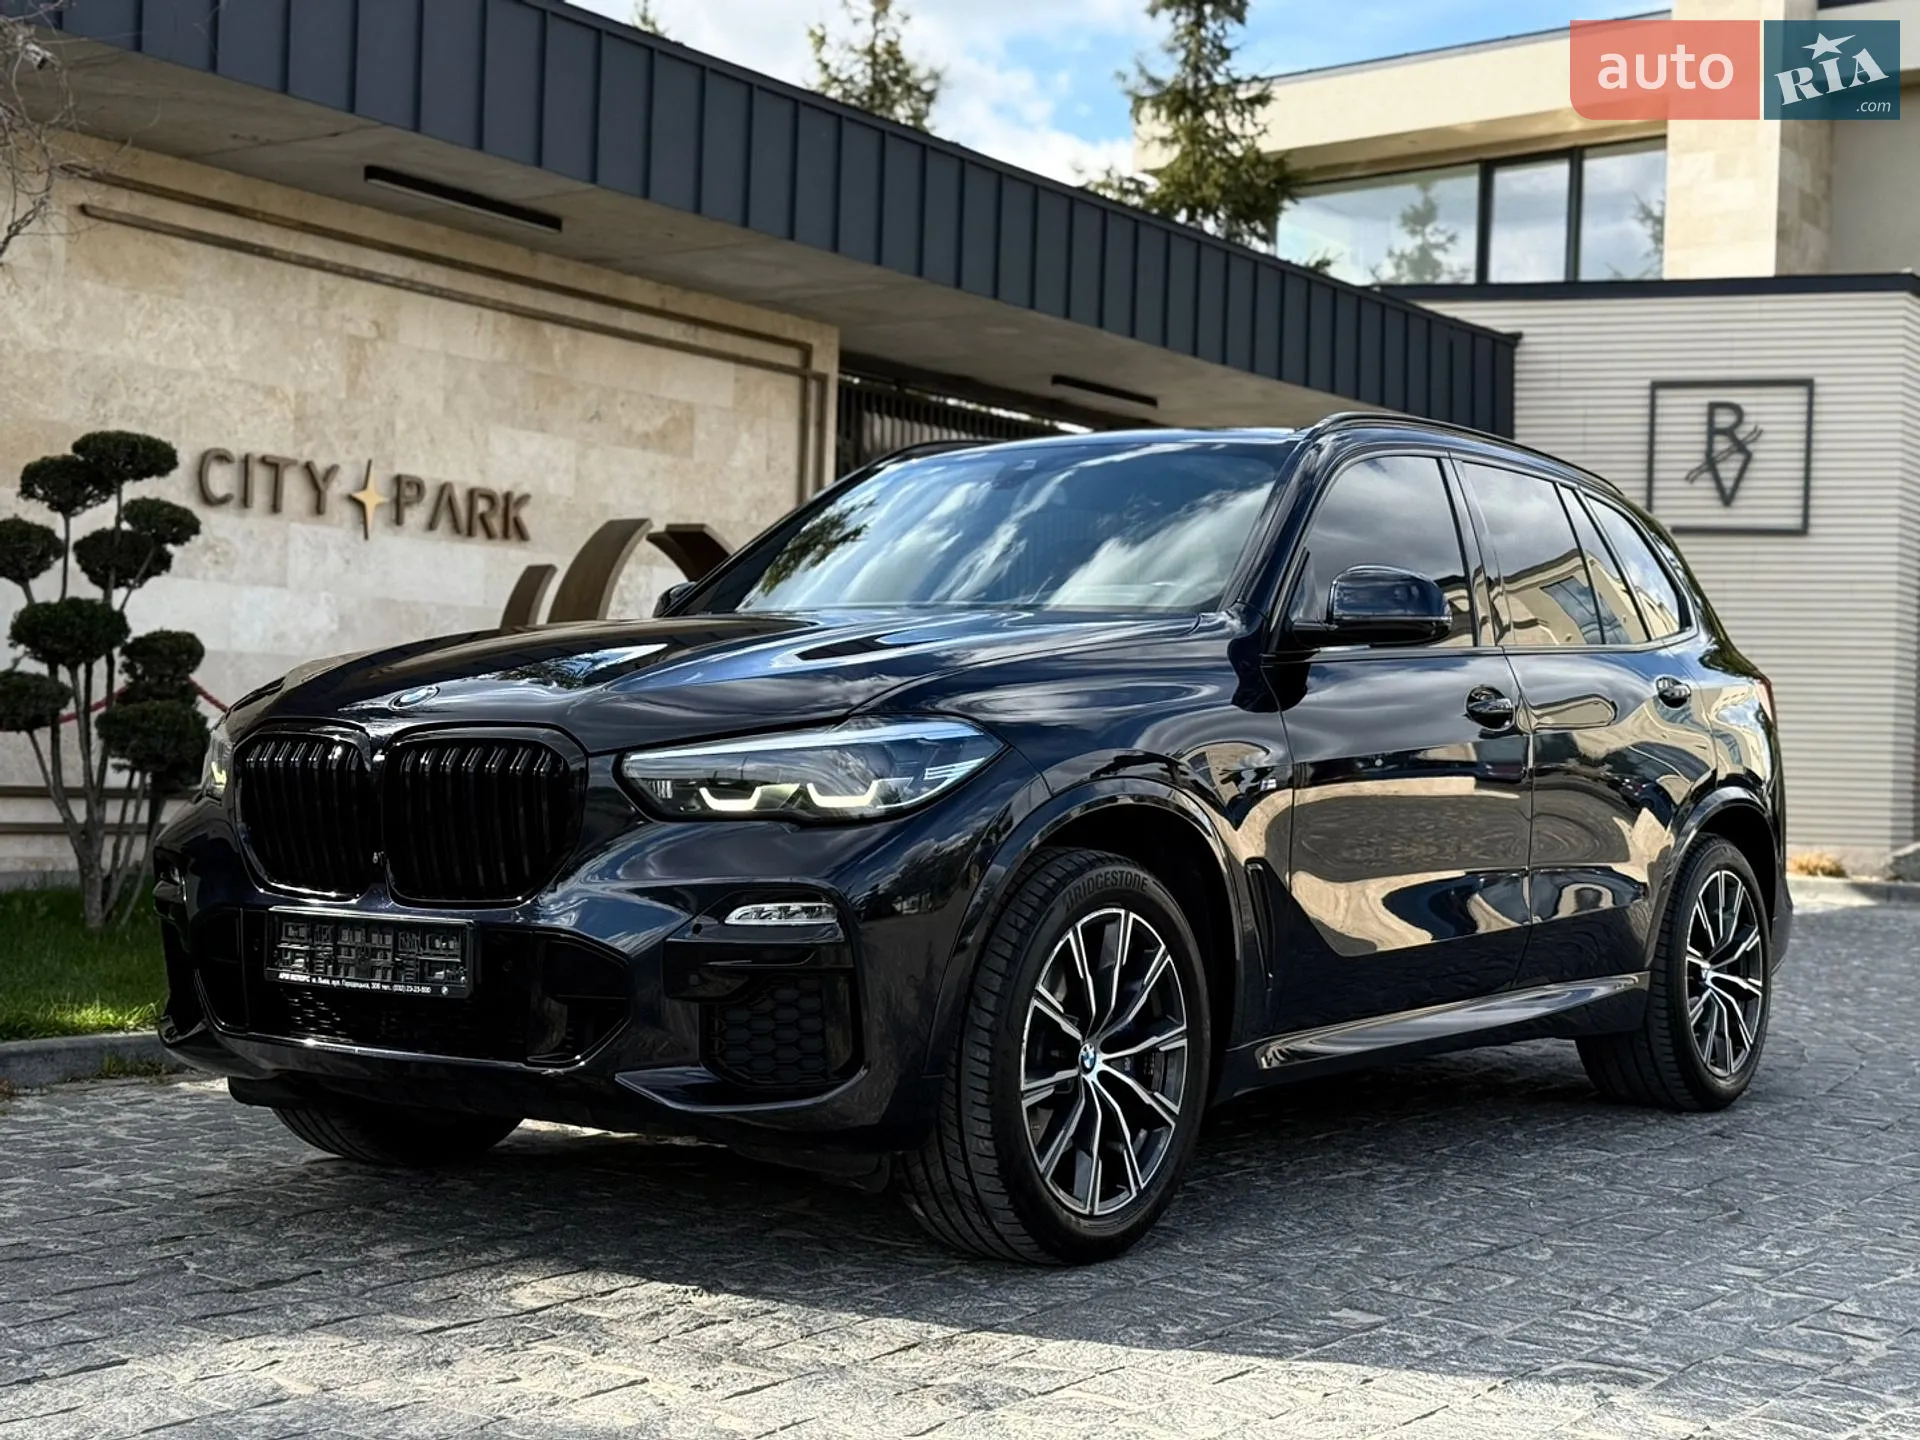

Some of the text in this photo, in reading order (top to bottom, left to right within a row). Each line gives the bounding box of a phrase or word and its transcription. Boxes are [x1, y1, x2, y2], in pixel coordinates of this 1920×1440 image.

[198, 447, 532, 542] CITY PARK
[1066, 870, 1149, 911] BRIDGESTONE
